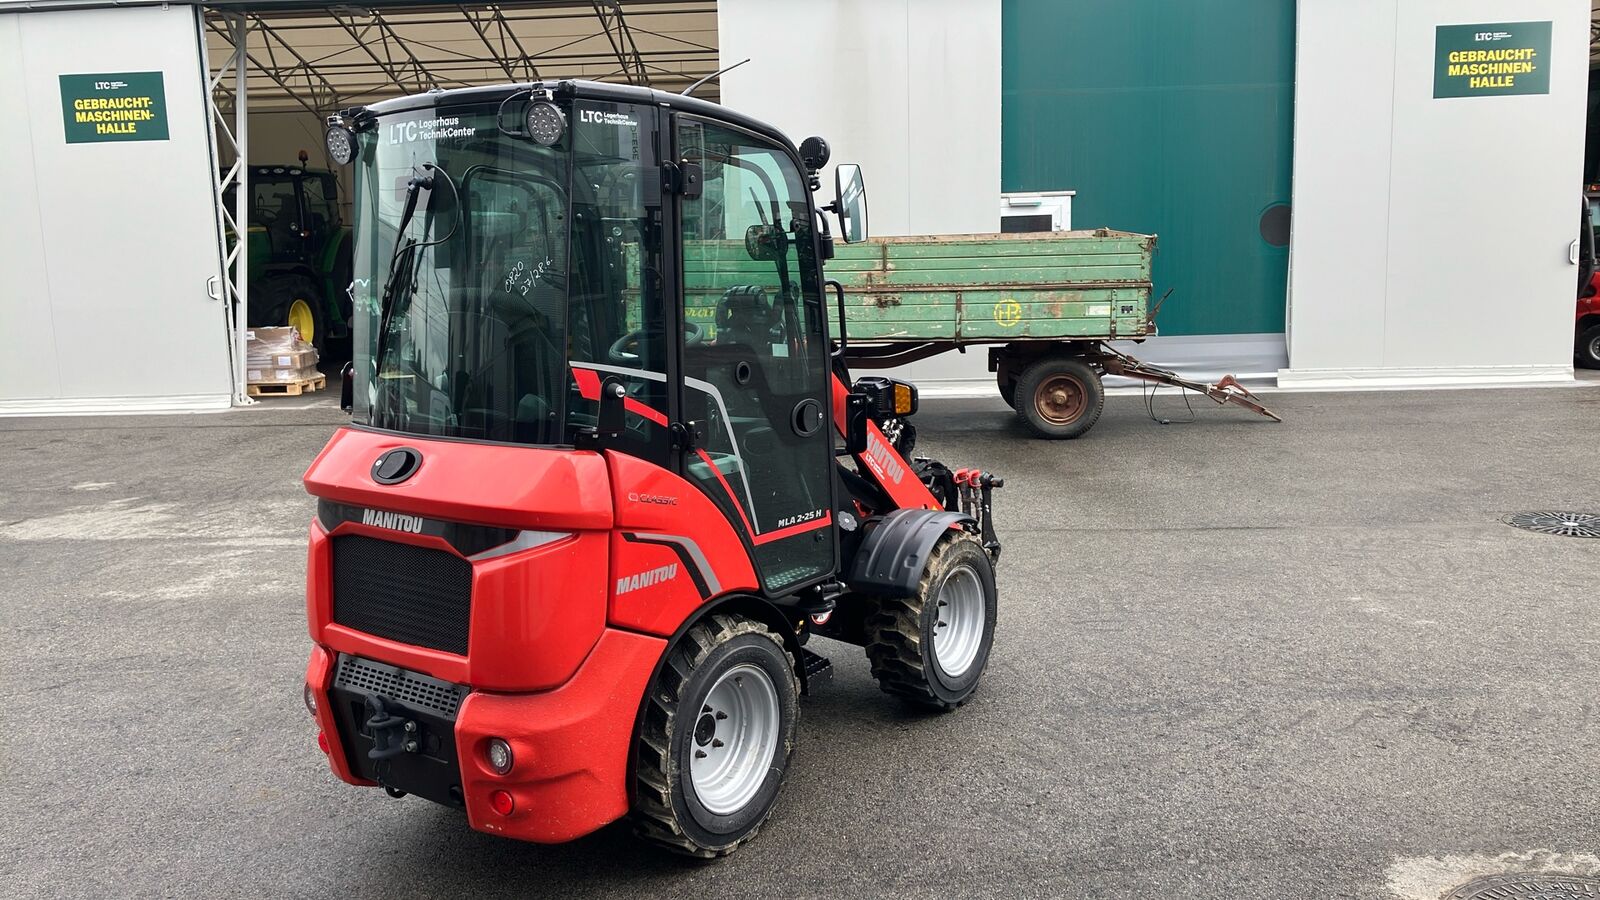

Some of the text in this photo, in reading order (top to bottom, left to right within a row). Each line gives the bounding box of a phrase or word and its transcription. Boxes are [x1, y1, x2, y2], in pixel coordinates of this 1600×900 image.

[1475, 32, 1492, 41] LTC
[1449, 48, 1537, 63] GEBRAUCHT-
[1448, 62, 1537, 76] MASCHINEN-
[95, 81, 110, 90] LTC
[1470, 75, 1514, 88] HALLE
[74, 97, 153, 110] GEBRAUCHT-
[75, 109, 154, 122] MASCHINEN-
[580, 109, 603, 124] LTC
[603, 111, 629, 120] Lagerhaus
[96, 122, 136, 134] HALLE
[419, 116, 459, 130] Lagerhaus
[390, 120, 417, 145] LTC
[419, 127, 476, 140] TechnikCenter
[867, 431, 904, 484] ANITOU
[639, 493, 678, 506] CLASSIC
[363, 509, 423, 534] MANITOU
[778, 508, 822, 528] MLA 2-25 H
[616, 563, 678, 595] MANITOU
